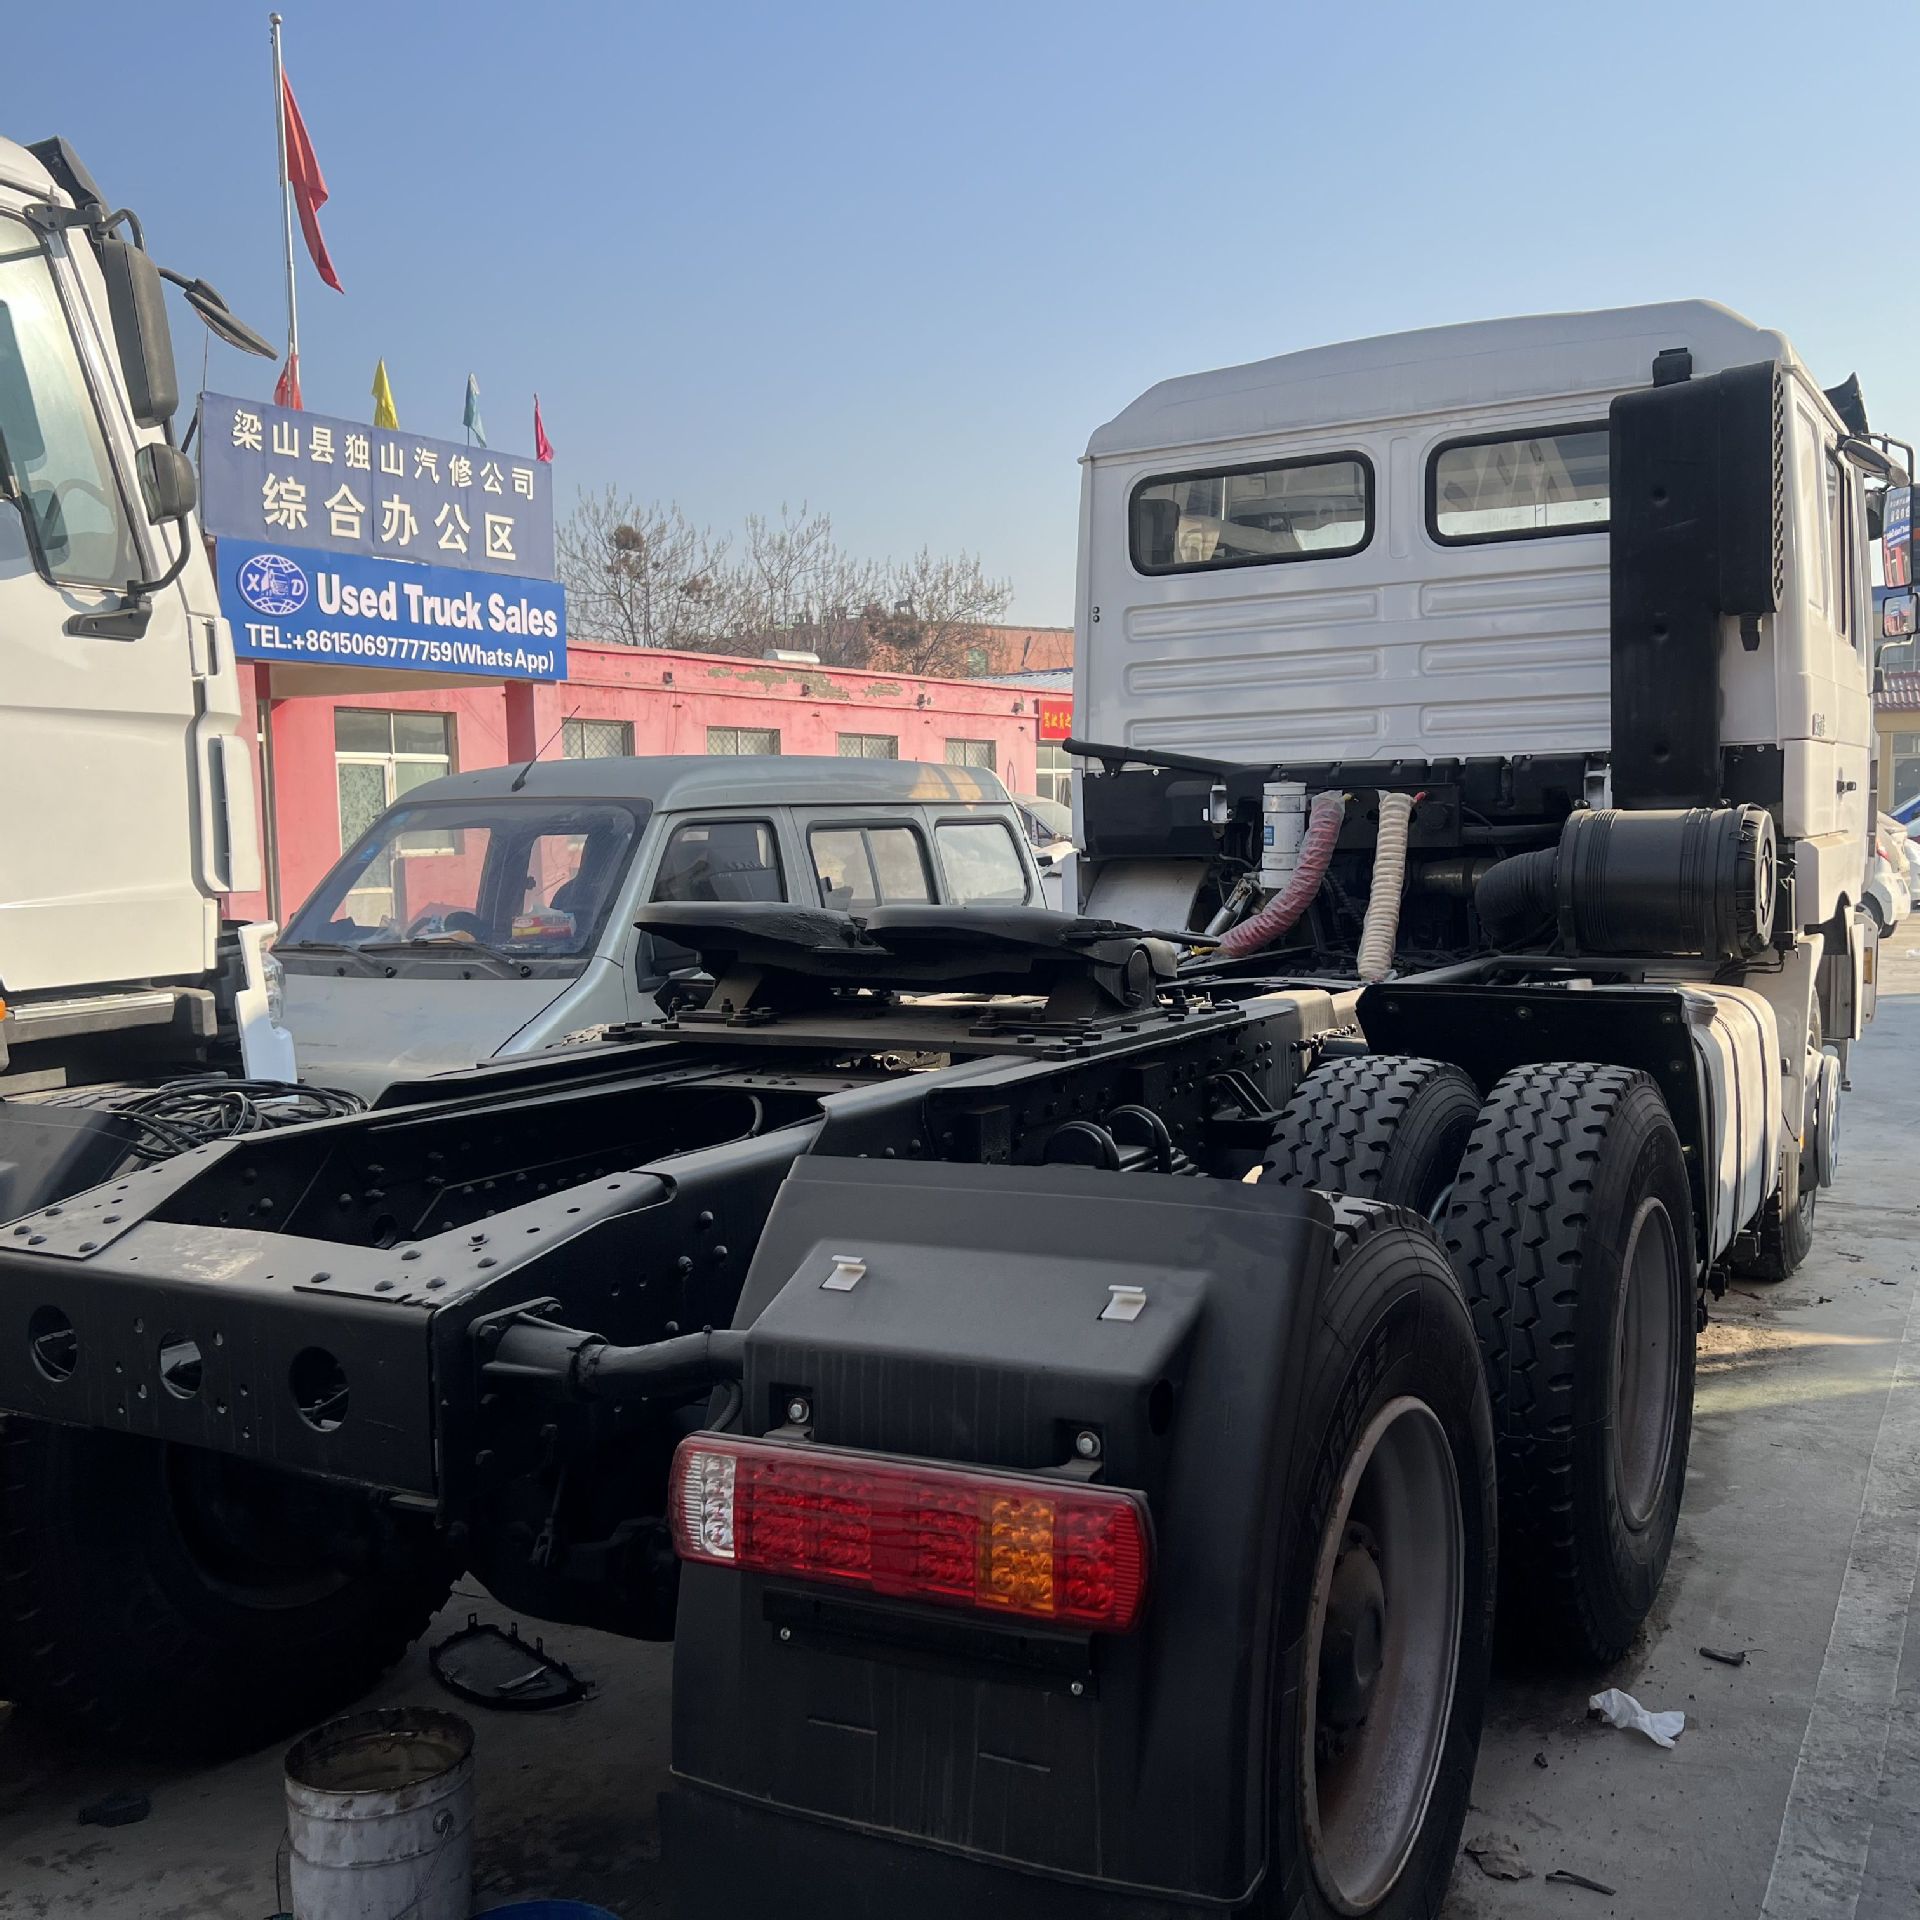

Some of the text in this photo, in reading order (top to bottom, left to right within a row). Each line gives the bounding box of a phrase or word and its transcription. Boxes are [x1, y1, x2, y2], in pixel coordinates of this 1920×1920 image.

[232, 408, 534, 500] 梁山县独山汽修公司
[261, 472, 516, 561] 综合办公区
[317, 572, 558, 638] Used Truck Sales
